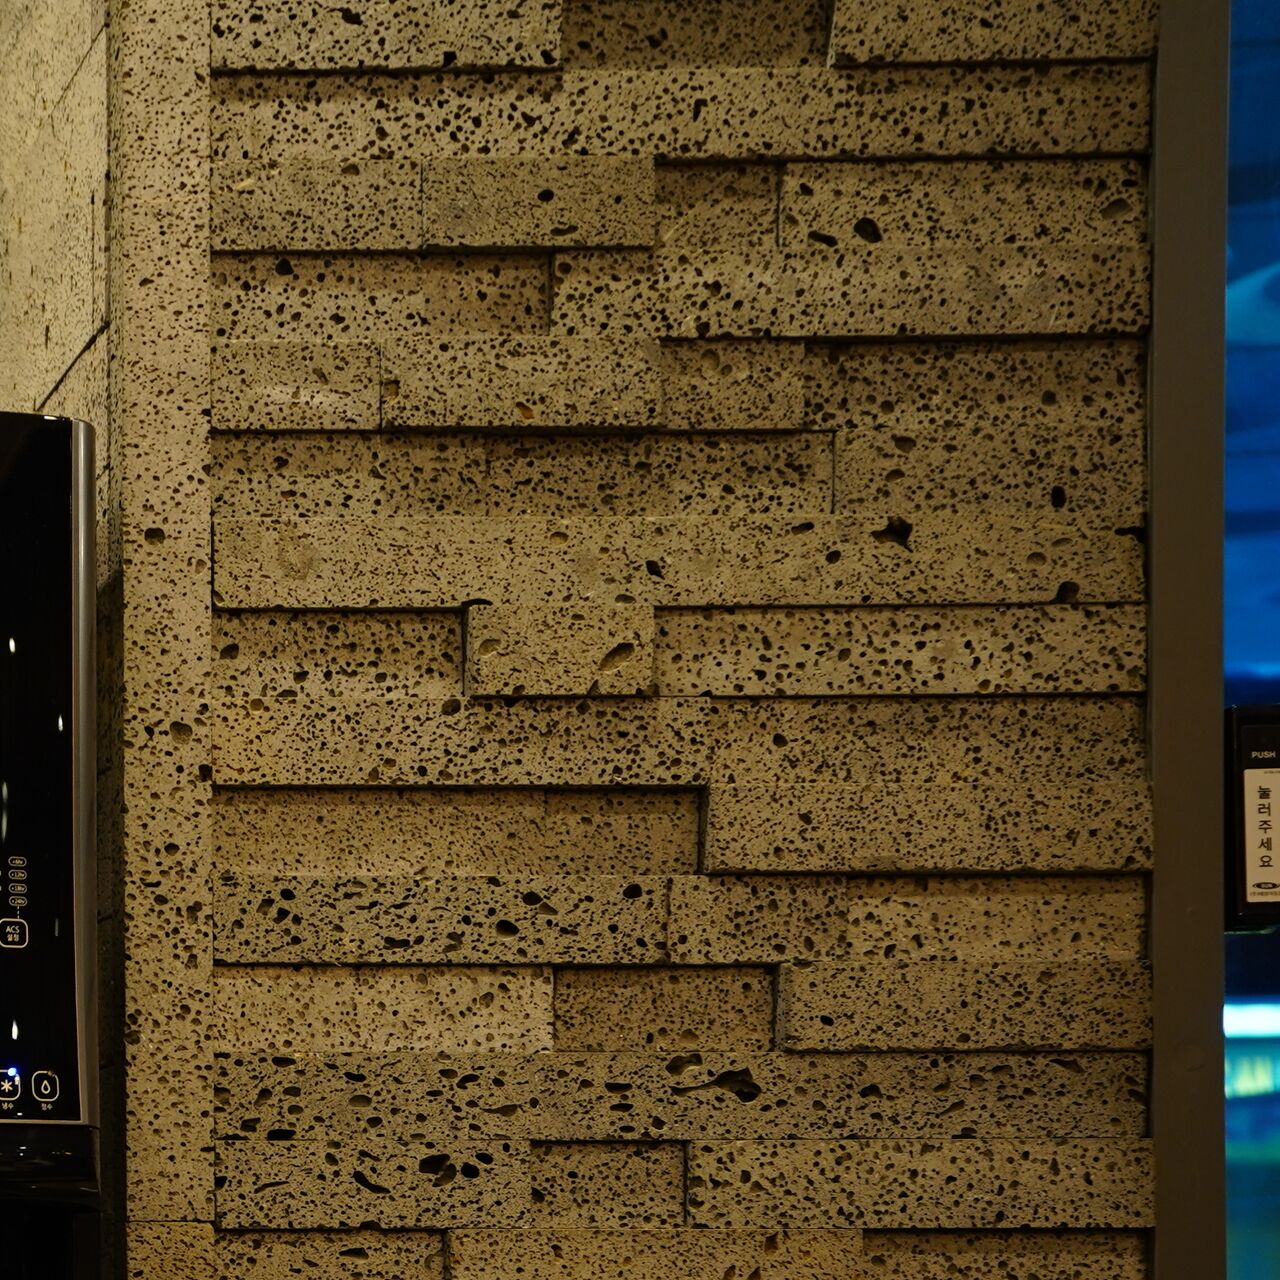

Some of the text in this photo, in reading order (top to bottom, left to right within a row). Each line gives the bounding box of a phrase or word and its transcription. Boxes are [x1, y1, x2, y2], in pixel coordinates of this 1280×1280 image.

[1251, 751, 1276, 759] PUSH
[1257, 785, 1274, 868] 눌러주세요
[6, 926, 20, 934] ACS
